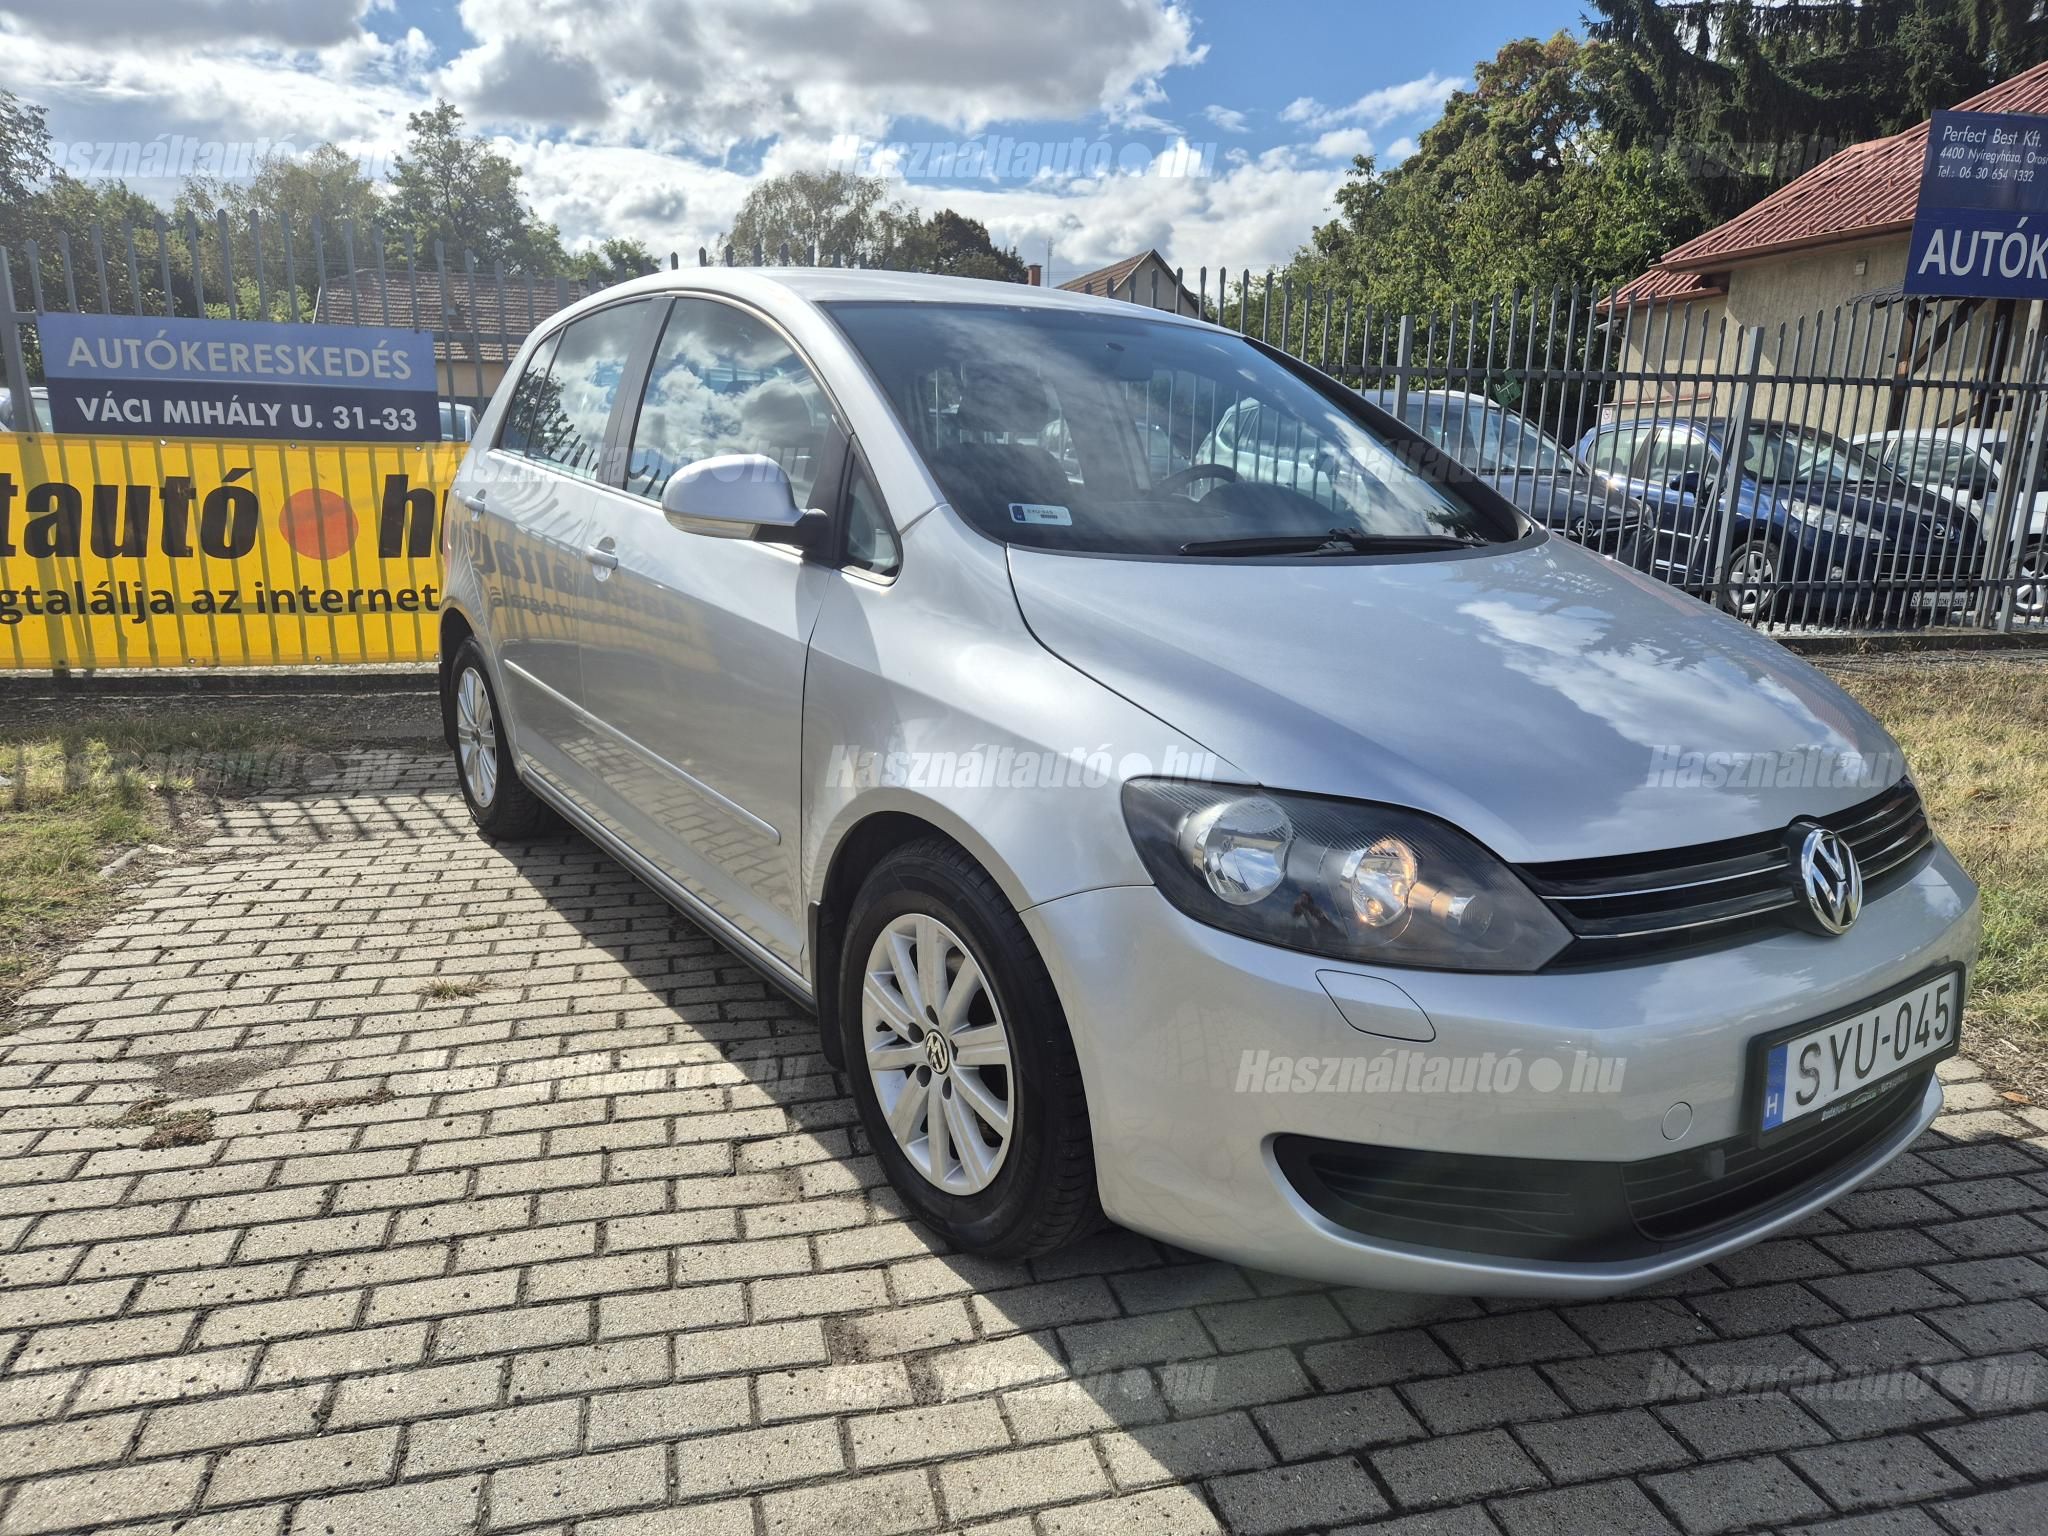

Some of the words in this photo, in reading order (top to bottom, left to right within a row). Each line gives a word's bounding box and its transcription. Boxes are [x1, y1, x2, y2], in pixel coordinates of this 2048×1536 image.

[1940, 147, 1965, 160] 4400
[1968, 149, 2022, 164] Nyíregyháza,
[1943, 126, 1987, 143] Perfect
[1992, 128, 2018, 144] Best
[2023, 130, 2042, 147] Kft.
[1960, 166, 1972, 179] 06
[1976, 167, 1988, 180] 30
[1992, 168, 2009, 180] 654
[2014, 169, 2035, 182] 1332
[1918, 217, 2048, 280] AUTÓK
[68, 330, 412, 380] AUTÓKERESKEDÉS
[76, 391, 152, 423] VÁCI
[163, 395, 281, 427] MIHÁLY
[291, 405, 323, 429] U.
[332, 406, 417, 432] 31-33
[379, 474, 449, 559] h
[0, 581, 175, 624] gtalálja
[191, 588, 242, 614] az
[255, 581, 439, 614] internet
[1796, 983, 1950, 1106] SYU-045
[1765, 1093, 1779, 1118] H
